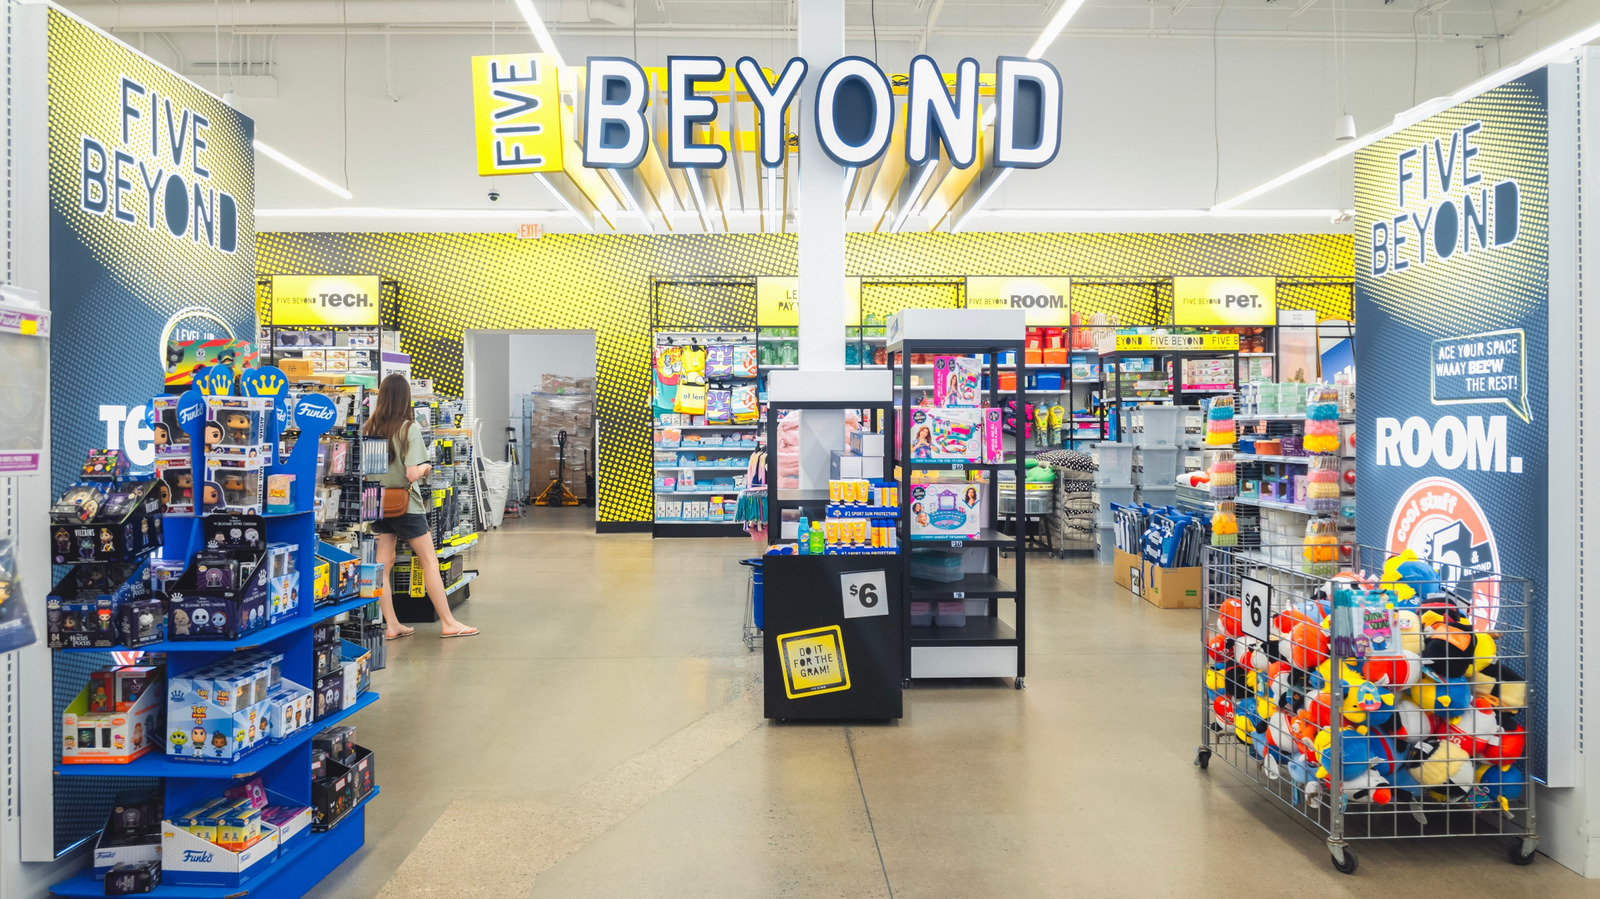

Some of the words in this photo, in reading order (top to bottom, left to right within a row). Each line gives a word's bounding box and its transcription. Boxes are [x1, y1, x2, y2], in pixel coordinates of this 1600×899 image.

[492, 54, 545, 168] FIVE
[583, 54, 1063, 170] BEYOND
[121, 76, 210, 180] FIVE
[1398, 121, 1482, 208] FIVE
[82, 136, 238, 253] BEYOND
[520, 223, 539, 238] EXIT
[1372, 181, 1519, 276] BEYOND
[276, 296, 291, 304] FIVE
[292, 296, 316, 304] BEYOND
[778, 301, 795, 312] PAY
[968, 297, 983, 305] FIVE
[984, 297, 1008, 305] BEYOND
[1010, 294, 1068, 309] ROOM.
[1182, 297, 1197, 305] FIVE
[1198, 297, 1222, 305] BEYOND
[176, 328, 200, 341] LEVEL
[1150, 336, 1169, 346] FIVE
[1171, 336, 1204, 346] BEYOND
[1212, 336, 1231, 346] FIVE
[1438, 344, 1456, 361] ACE
[1457, 342, 1485, 359] YOUR
[1486, 338, 1518, 356] SPACE
[1435, 361, 1467, 377] WAAAY
[1467, 358, 1505, 375] BELOW
[1465, 377, 1486, 392] THE
[1487, 375, 1518, 391] REST!
[179, 402, 204, 425] Funko
[297, 402, 335, 421] Funko
[1376, 415, 1523, 474] ROOM.
[1419, 491, 1458, 515] stuff
[1397, 500, 1421, 543] cool
[1471, 550, 1480, 564] &
[1463, 561, 1492, 577] BEYOND
[849, 582, 879, 609] $6
[1244, 594, 1262, 628] $6
[799, 646, 812, 657] DO
[814, 644, 824, 655] IT
[793, 657, 813, 669] FOR
[814, 653, 834, 664] THE
[800, 664, 830, 678] GRAM!
[96, 851, 116, 860] Funko
[182, 849, 214, 863] Funko
